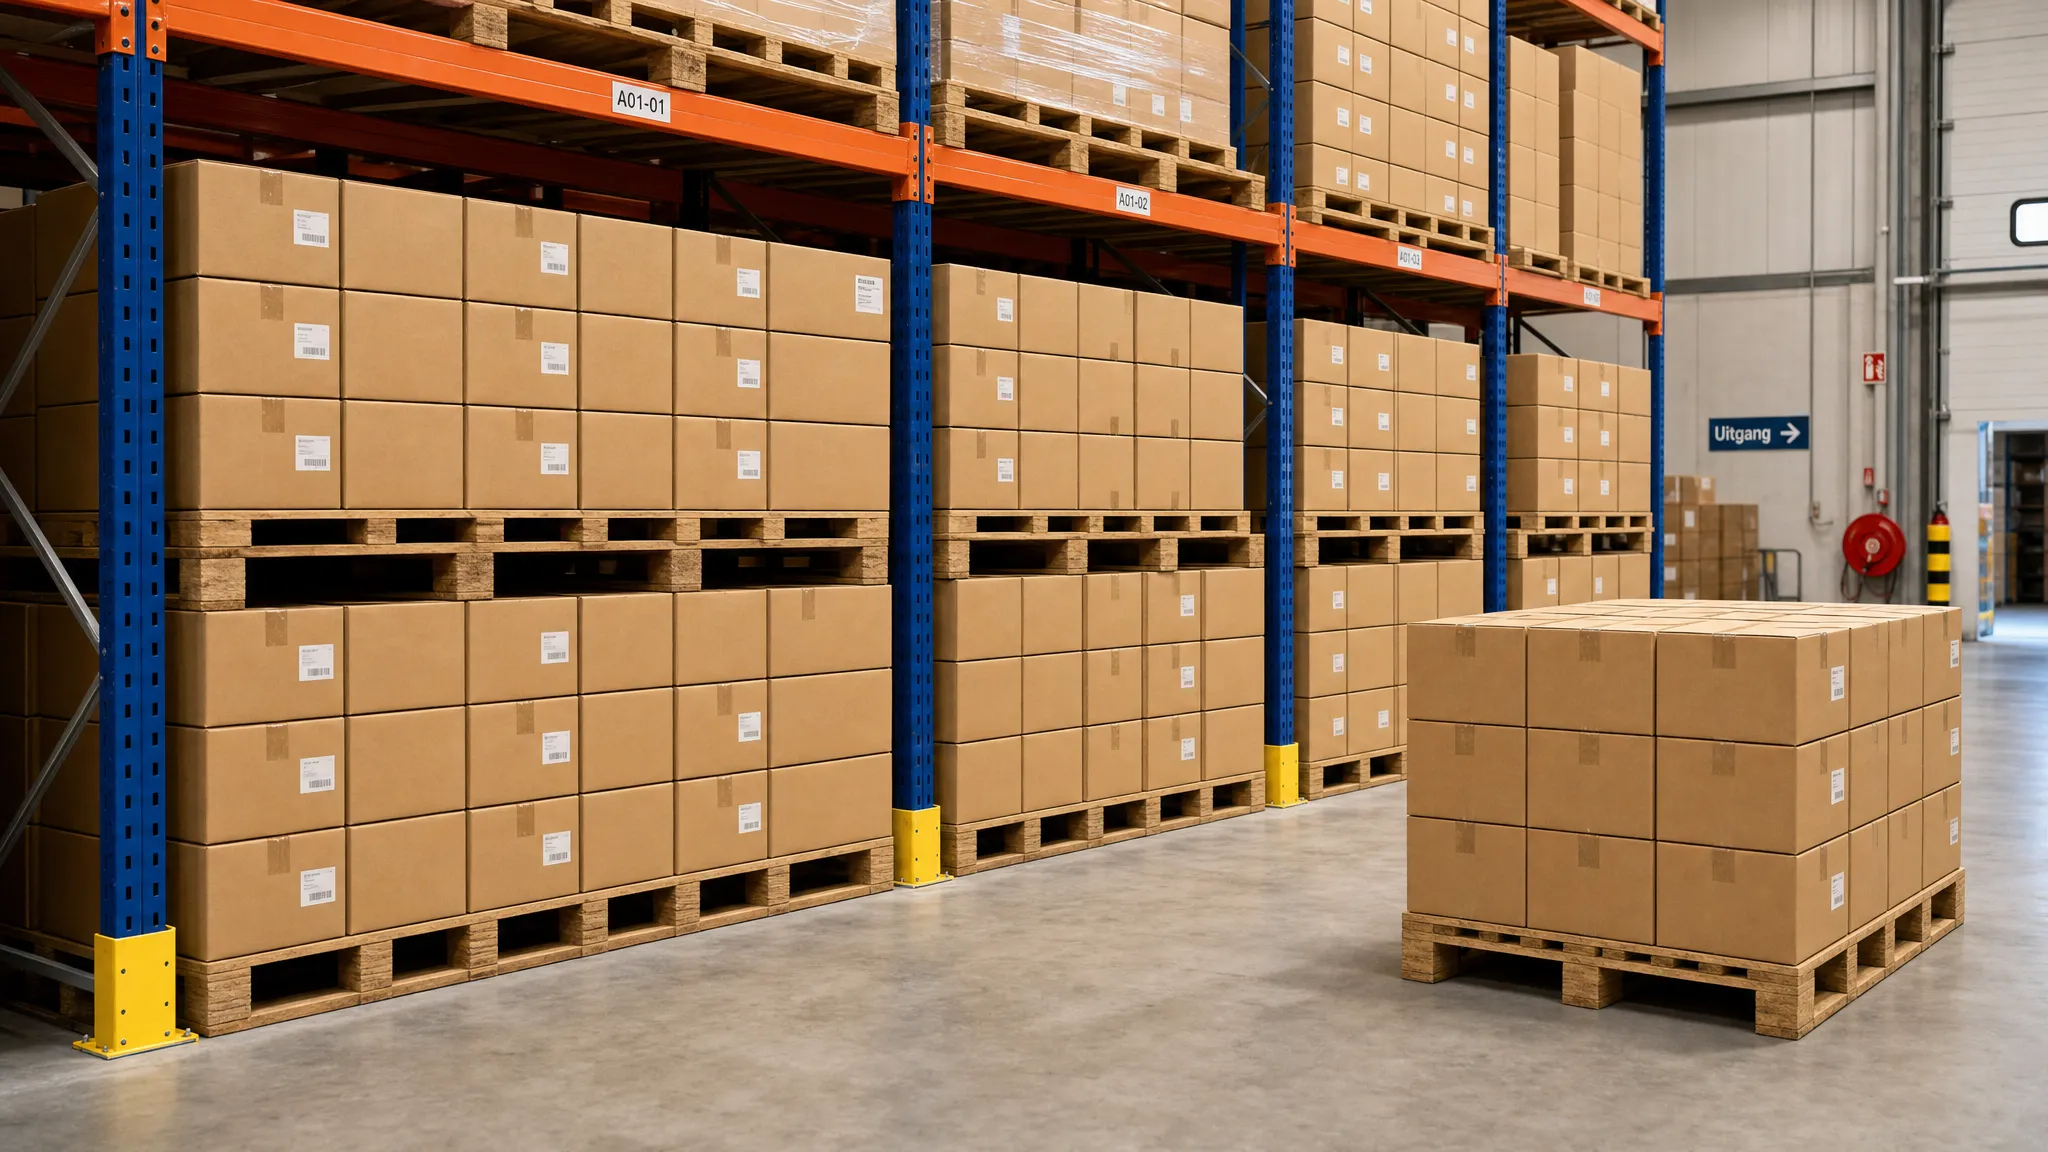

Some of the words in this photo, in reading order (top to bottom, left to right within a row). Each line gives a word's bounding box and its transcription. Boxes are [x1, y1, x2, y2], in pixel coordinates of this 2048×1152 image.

[617, 90, 664, 114] A01-01
[1119, 193, 1148, 210] A01-02
[1714, 425, 1771, 445] Uitgang
